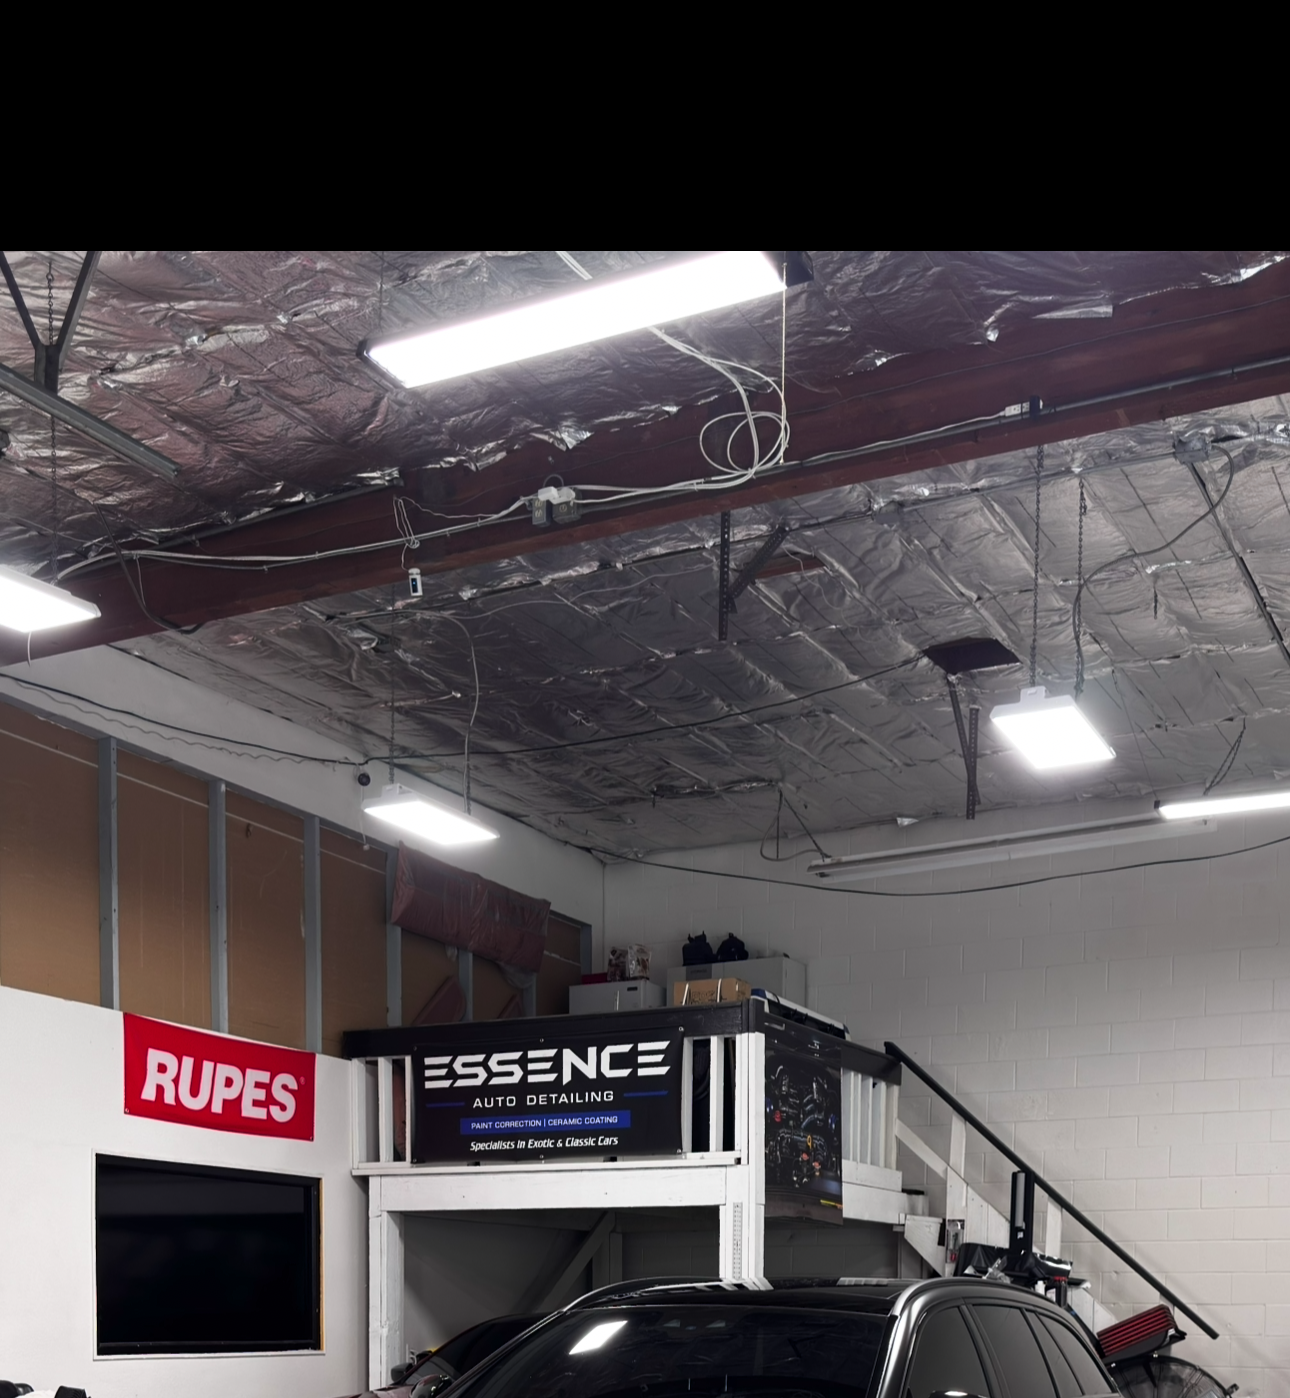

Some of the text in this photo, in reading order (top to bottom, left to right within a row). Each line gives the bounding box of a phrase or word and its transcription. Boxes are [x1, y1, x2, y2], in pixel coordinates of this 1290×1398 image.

[424, 1041, 671, 1088] ESSENCE
[140, 1047, 299, 1123] RUPES
[473, 1090, 614, 1108] AUTO DETAILING
[471, 1115, 618, 1130] PAINT CORRECTION CERAMIC COATING
[470, 1140, 515, 1152] Specialists
[527, 1138, 555, 1149] Exotic
[556, 1138, 563, 1148] &
[565, 1136, 597, 1147] Classic
[598, 1135, 619, 1146] Cars
